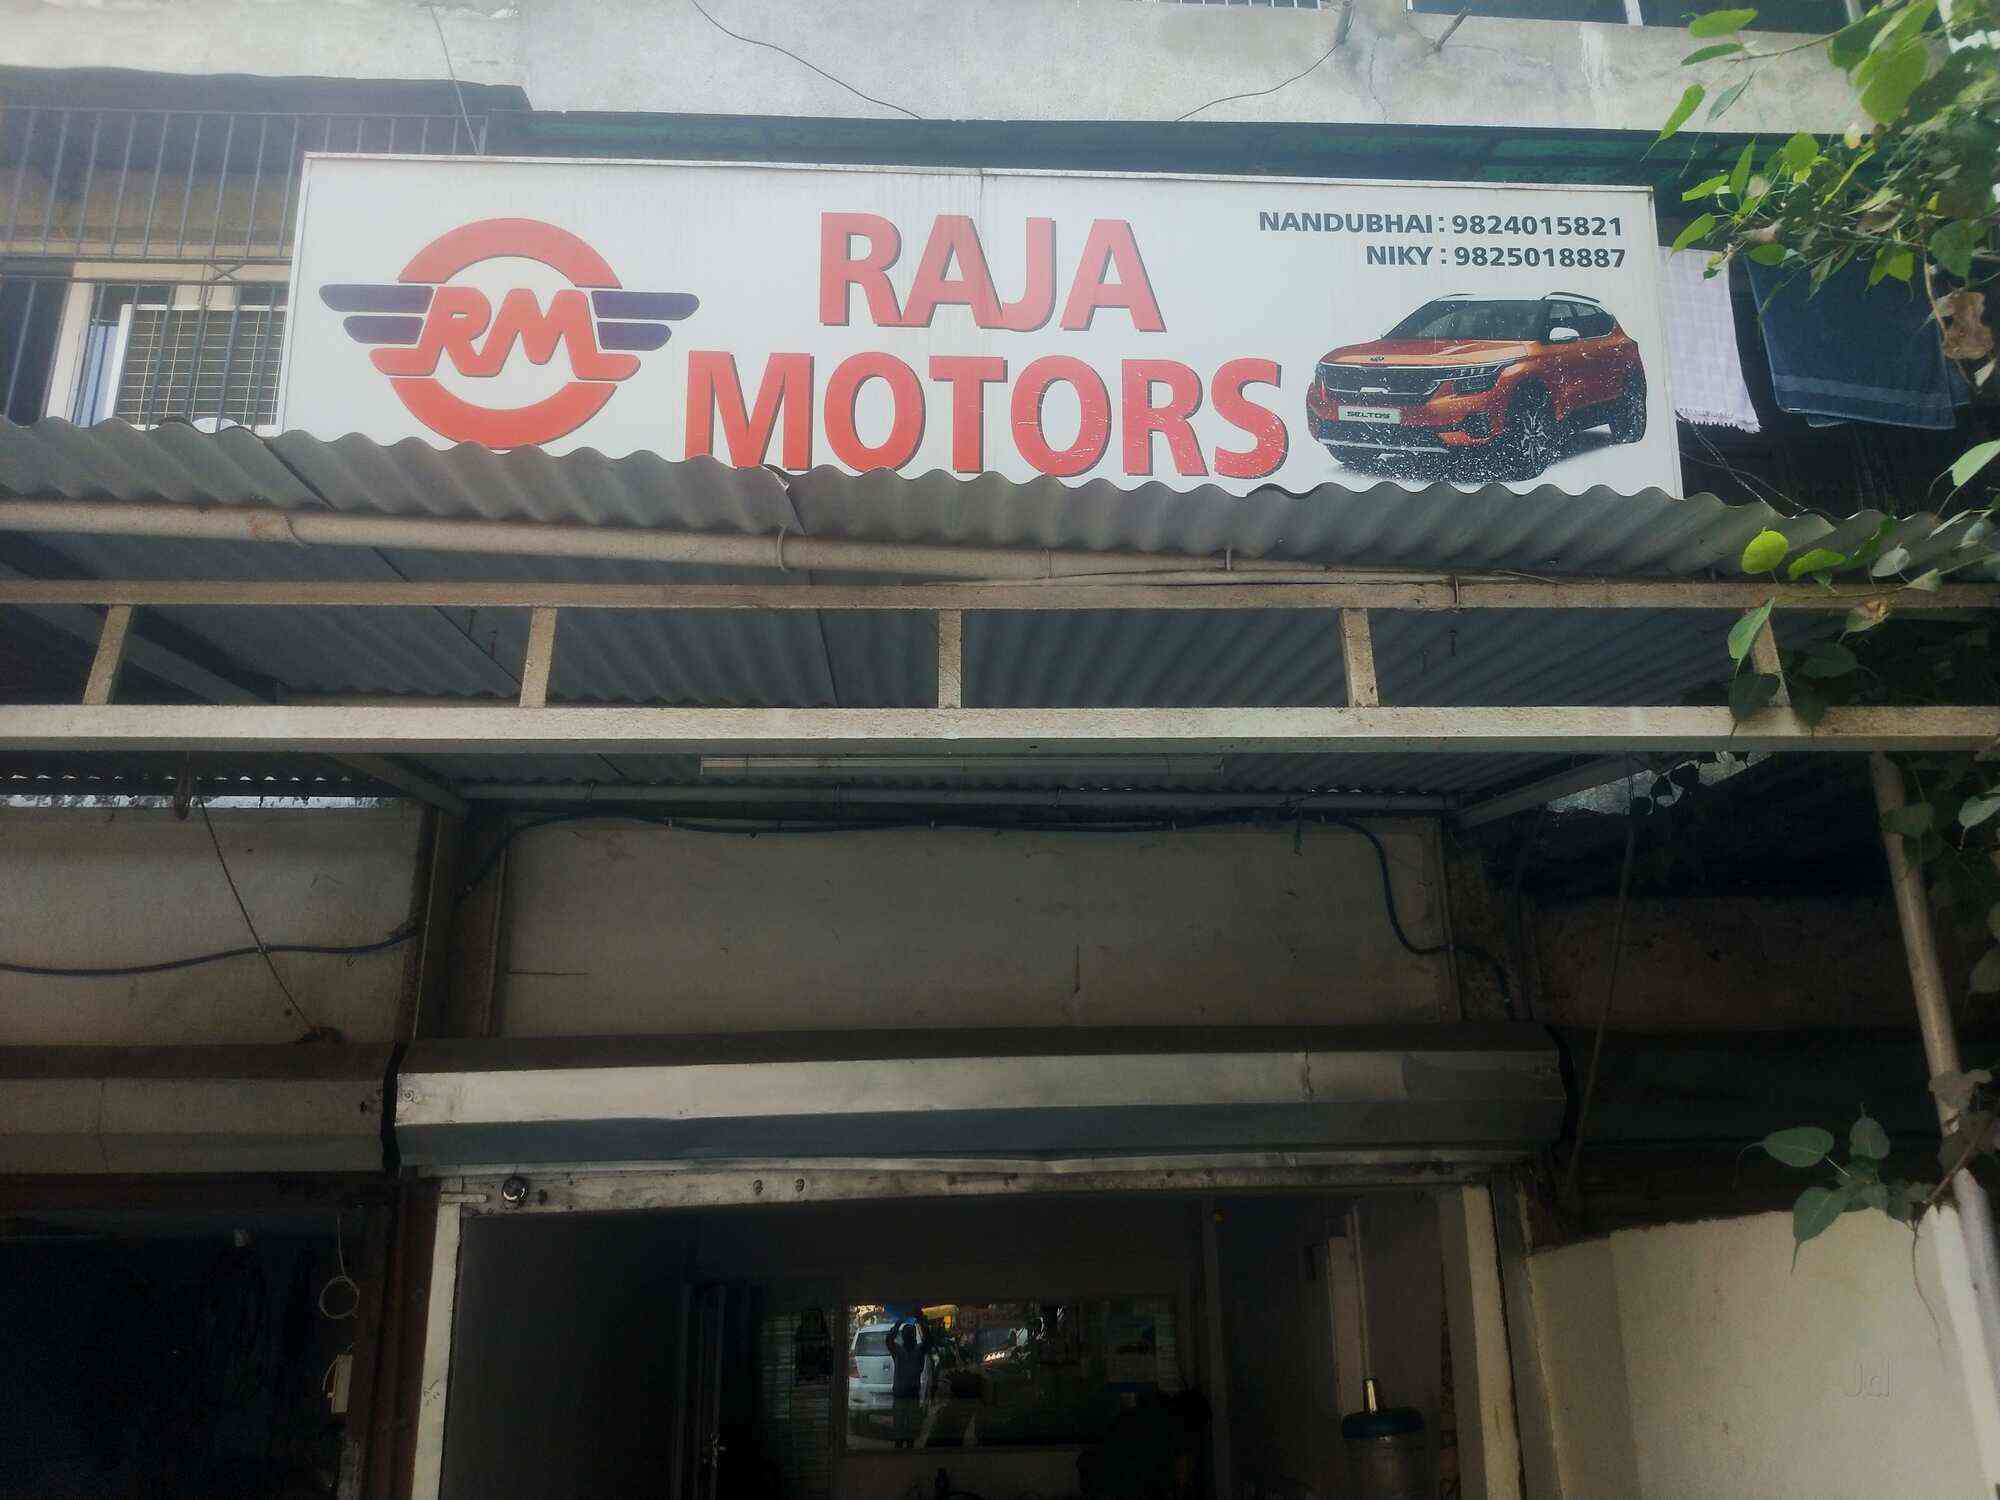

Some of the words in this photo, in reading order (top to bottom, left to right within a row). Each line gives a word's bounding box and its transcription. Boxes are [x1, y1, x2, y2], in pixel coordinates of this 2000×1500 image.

[819, 211, 1167, 333] RAJA
[1451, 214, 1621, 236] 9824015821
[1454, 246, 1626, 268] 9825018887
[395, 286, 622, 381] RM
[685, 349, 1290, 480] MOTORS
